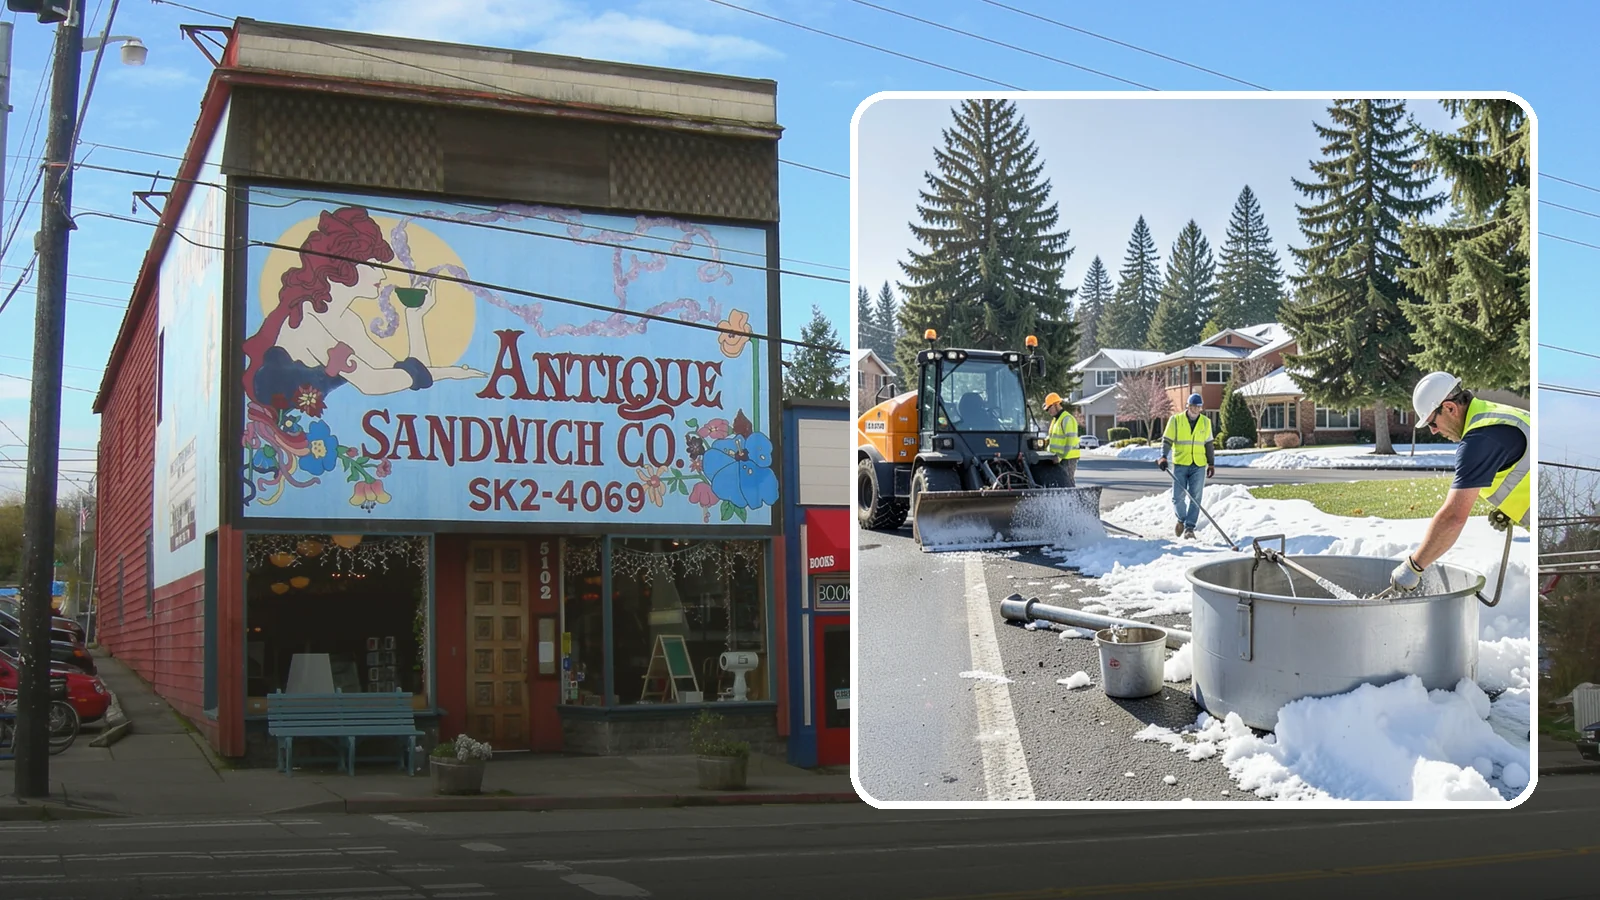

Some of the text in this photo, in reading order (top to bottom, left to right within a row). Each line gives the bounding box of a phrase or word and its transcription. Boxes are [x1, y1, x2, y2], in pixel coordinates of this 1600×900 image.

[475, 329, 724, 420] ANTIQUE
[360, 408, 685, 469] SANDWICH CO.
[468, 477, 646, 514] SK2-4069
[539, 542, 552, 600] 5102
[809, 555, 835, 569] BOOKS
